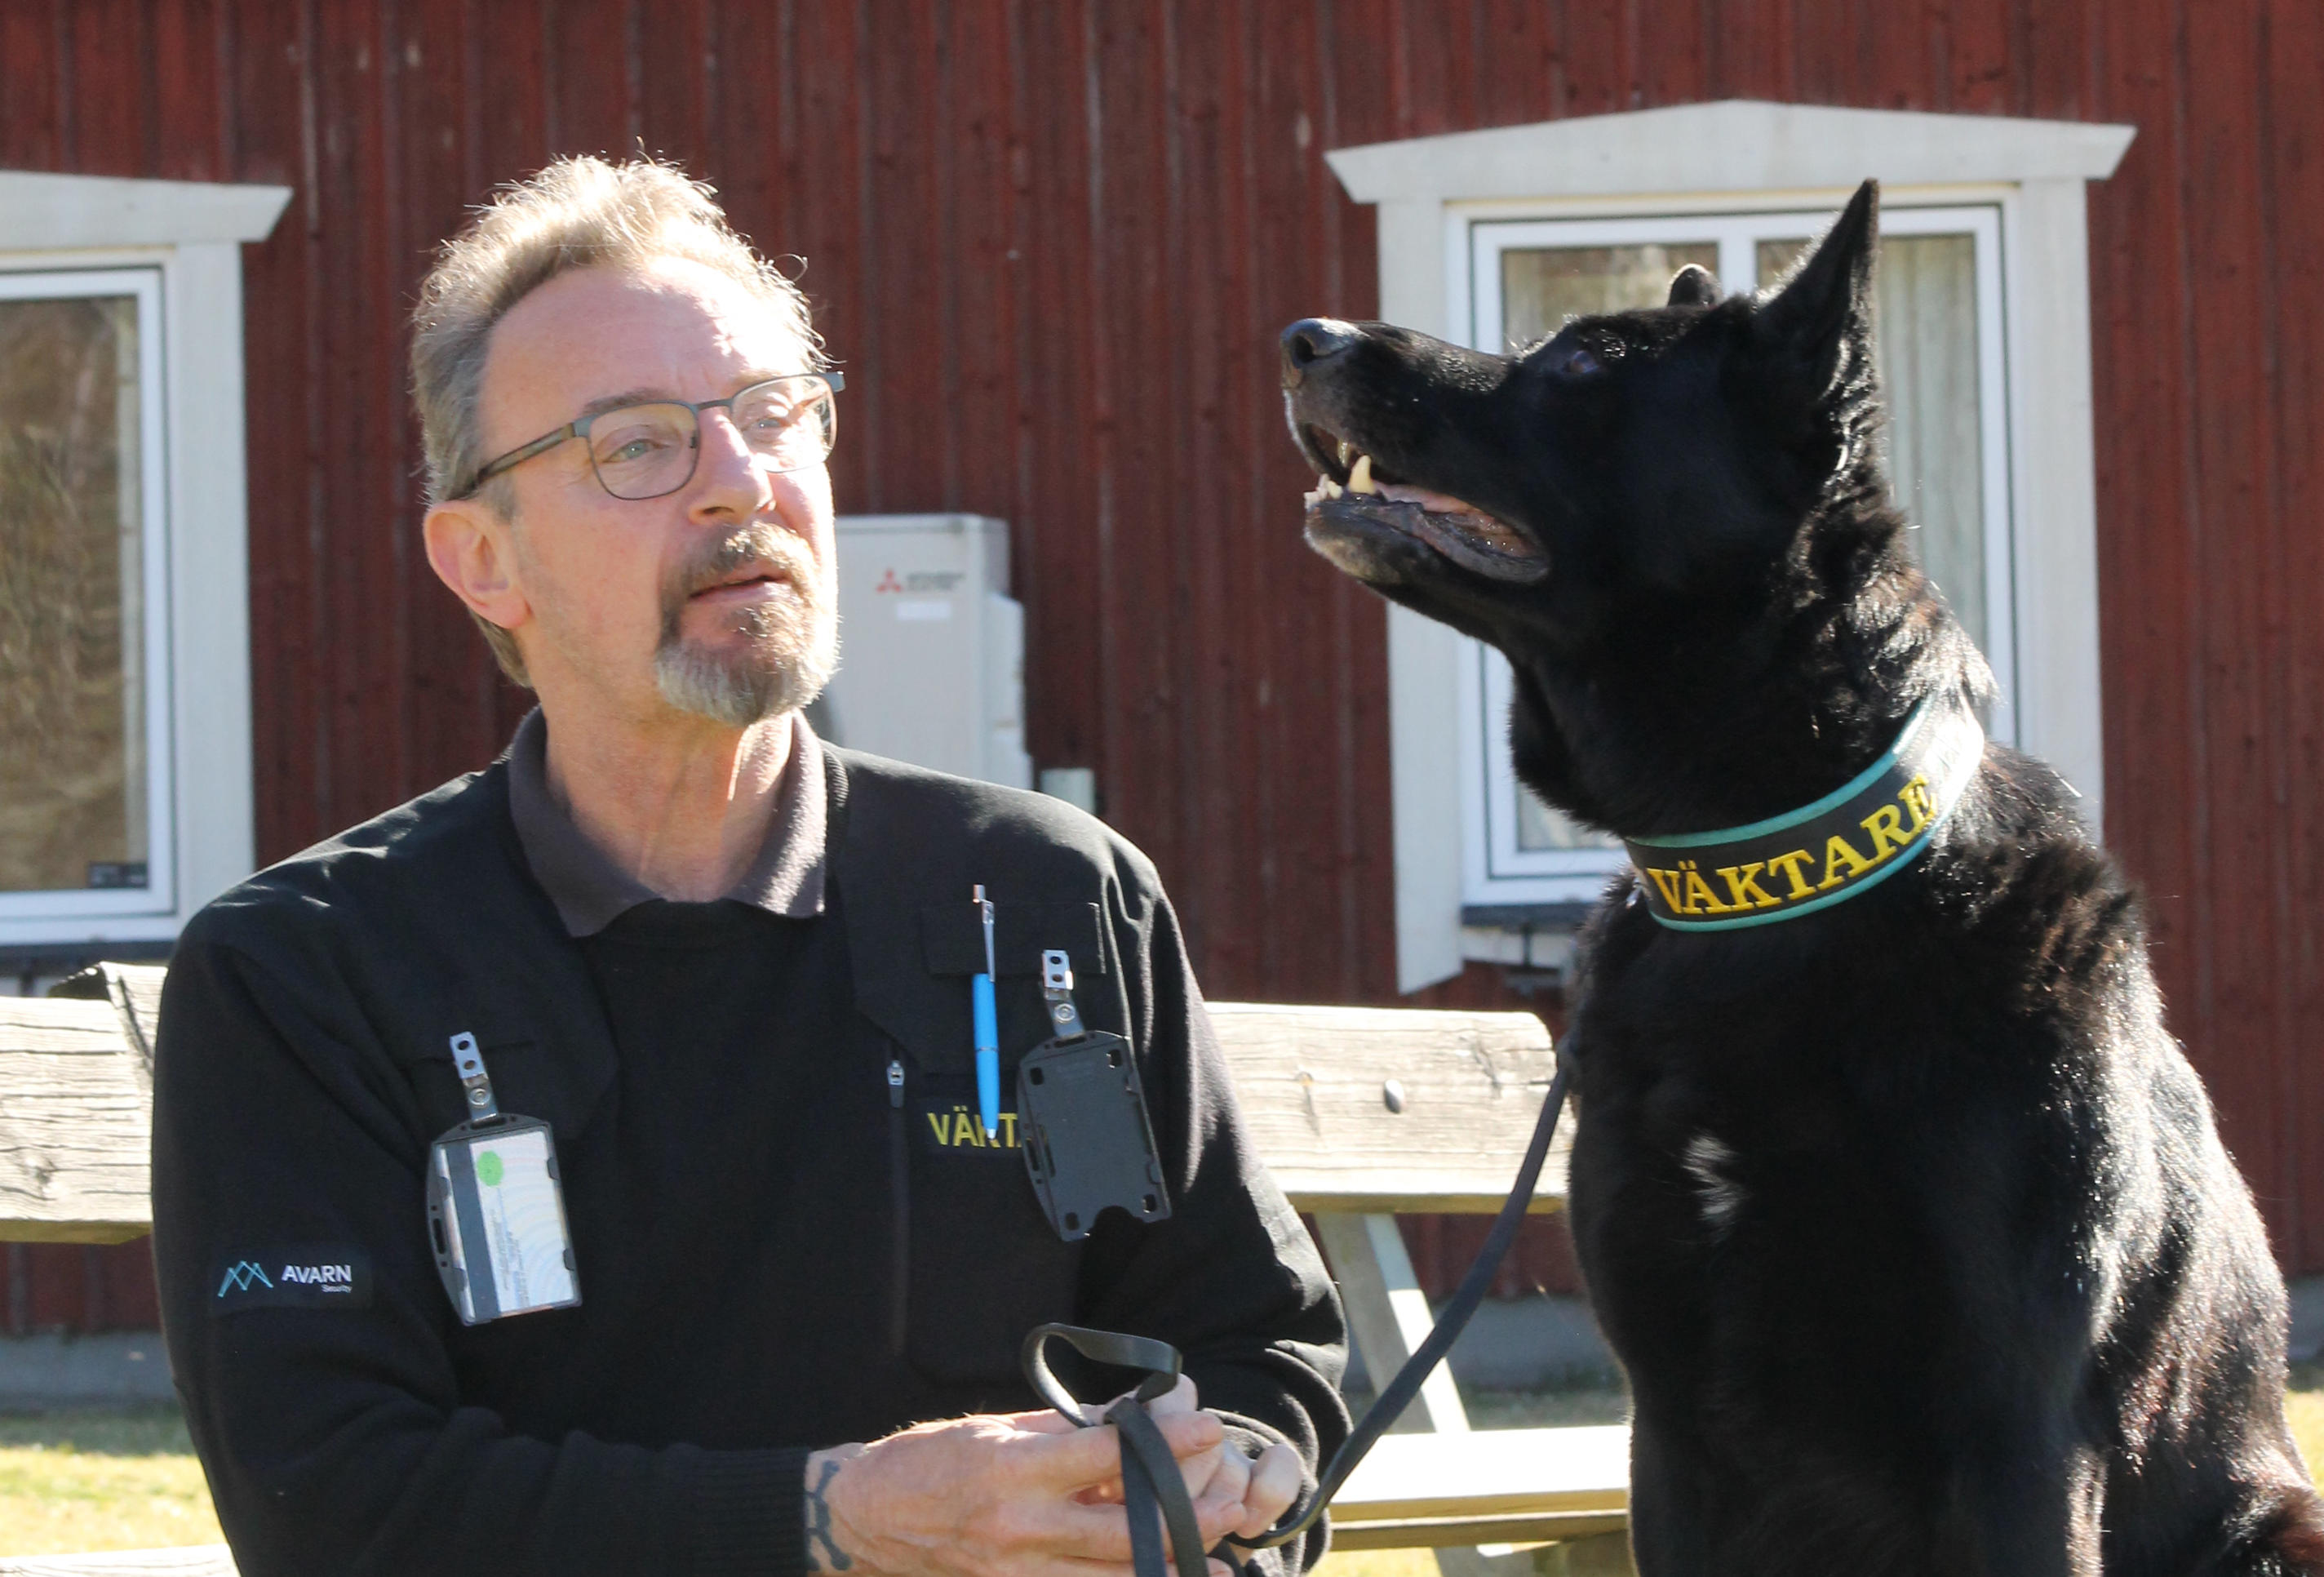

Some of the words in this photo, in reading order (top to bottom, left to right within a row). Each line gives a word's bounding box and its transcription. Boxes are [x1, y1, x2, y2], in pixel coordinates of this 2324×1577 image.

[1647, 772, 1938, 914] VÄKTARE
[926, 1104, 1022, 1148] VÄKT
[281, 1264, 353, 1284] AVARN
